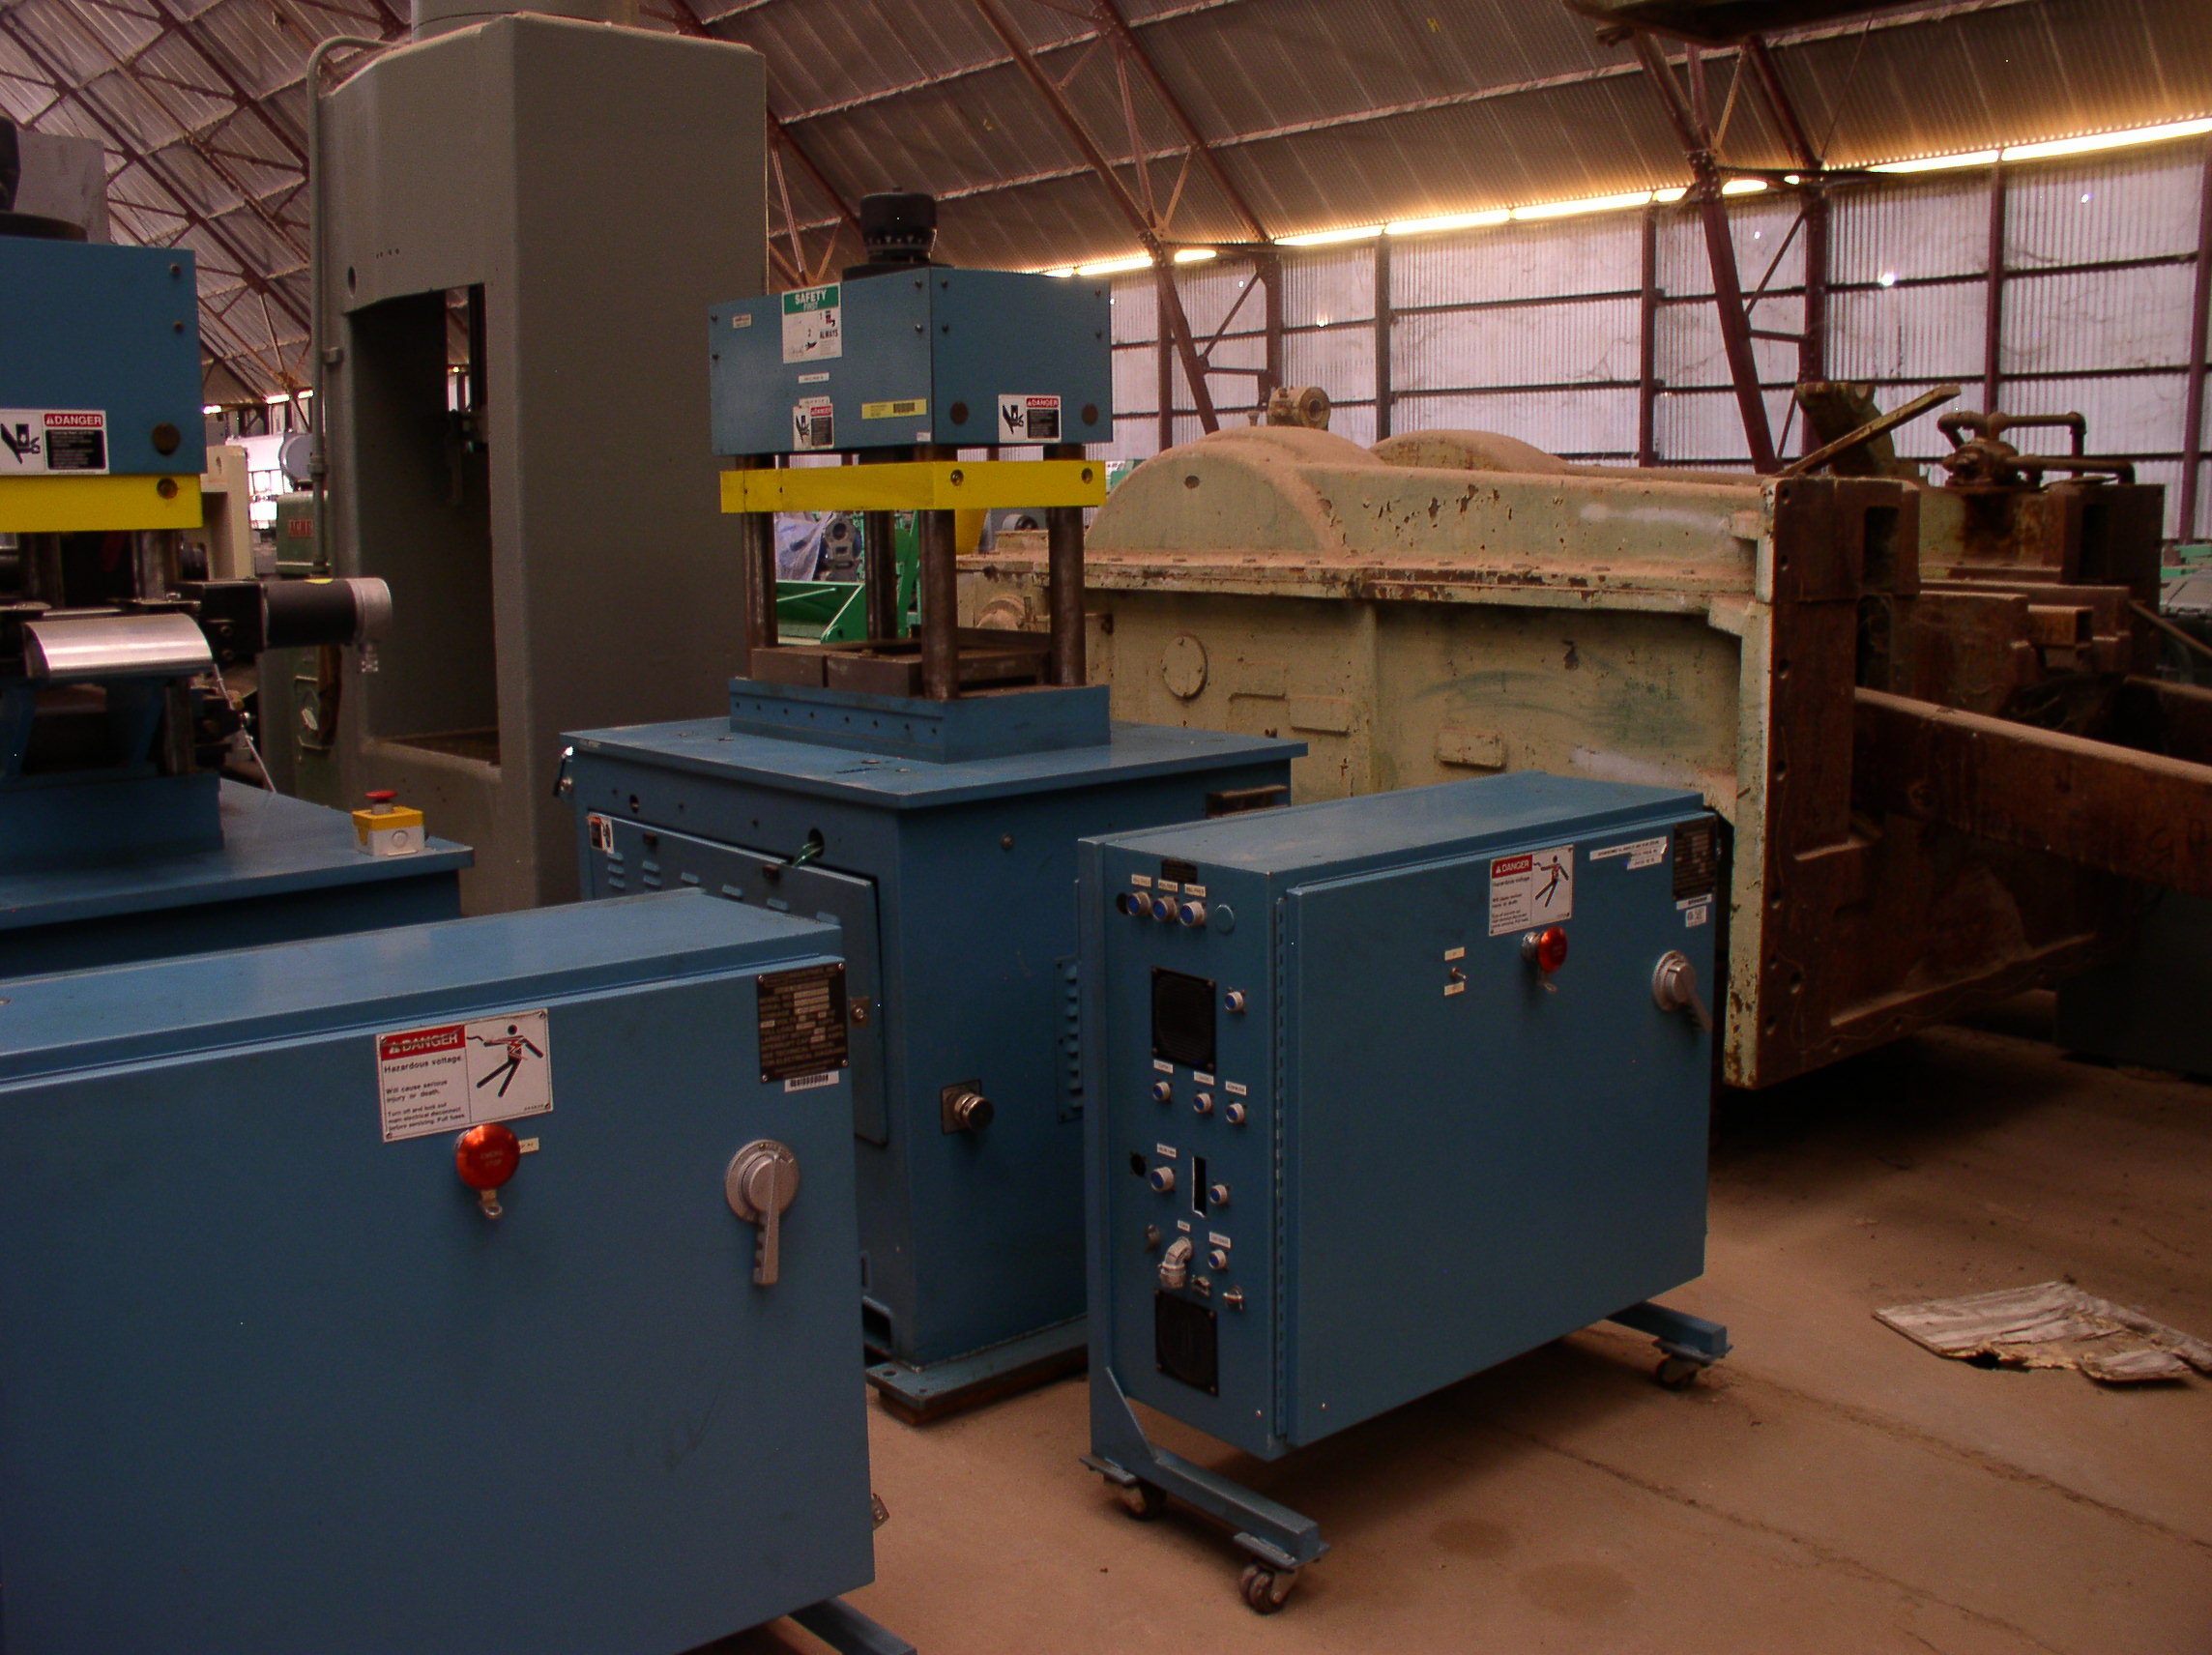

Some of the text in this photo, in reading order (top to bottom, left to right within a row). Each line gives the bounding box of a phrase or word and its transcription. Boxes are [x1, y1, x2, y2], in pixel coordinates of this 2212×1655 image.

[795, 289, 828, 305] SAFETY
[819, 329, 839, 339] ALWAYS
[1032, 398, 1059, 407] DANGER
[54, 416, 102, 425] DANGER
[1502, 860, 1528, 871] DANGER
[402, 1033, 458, 1052] DANGER
[384, 1057, 461, 1073] Hazardous voltage
